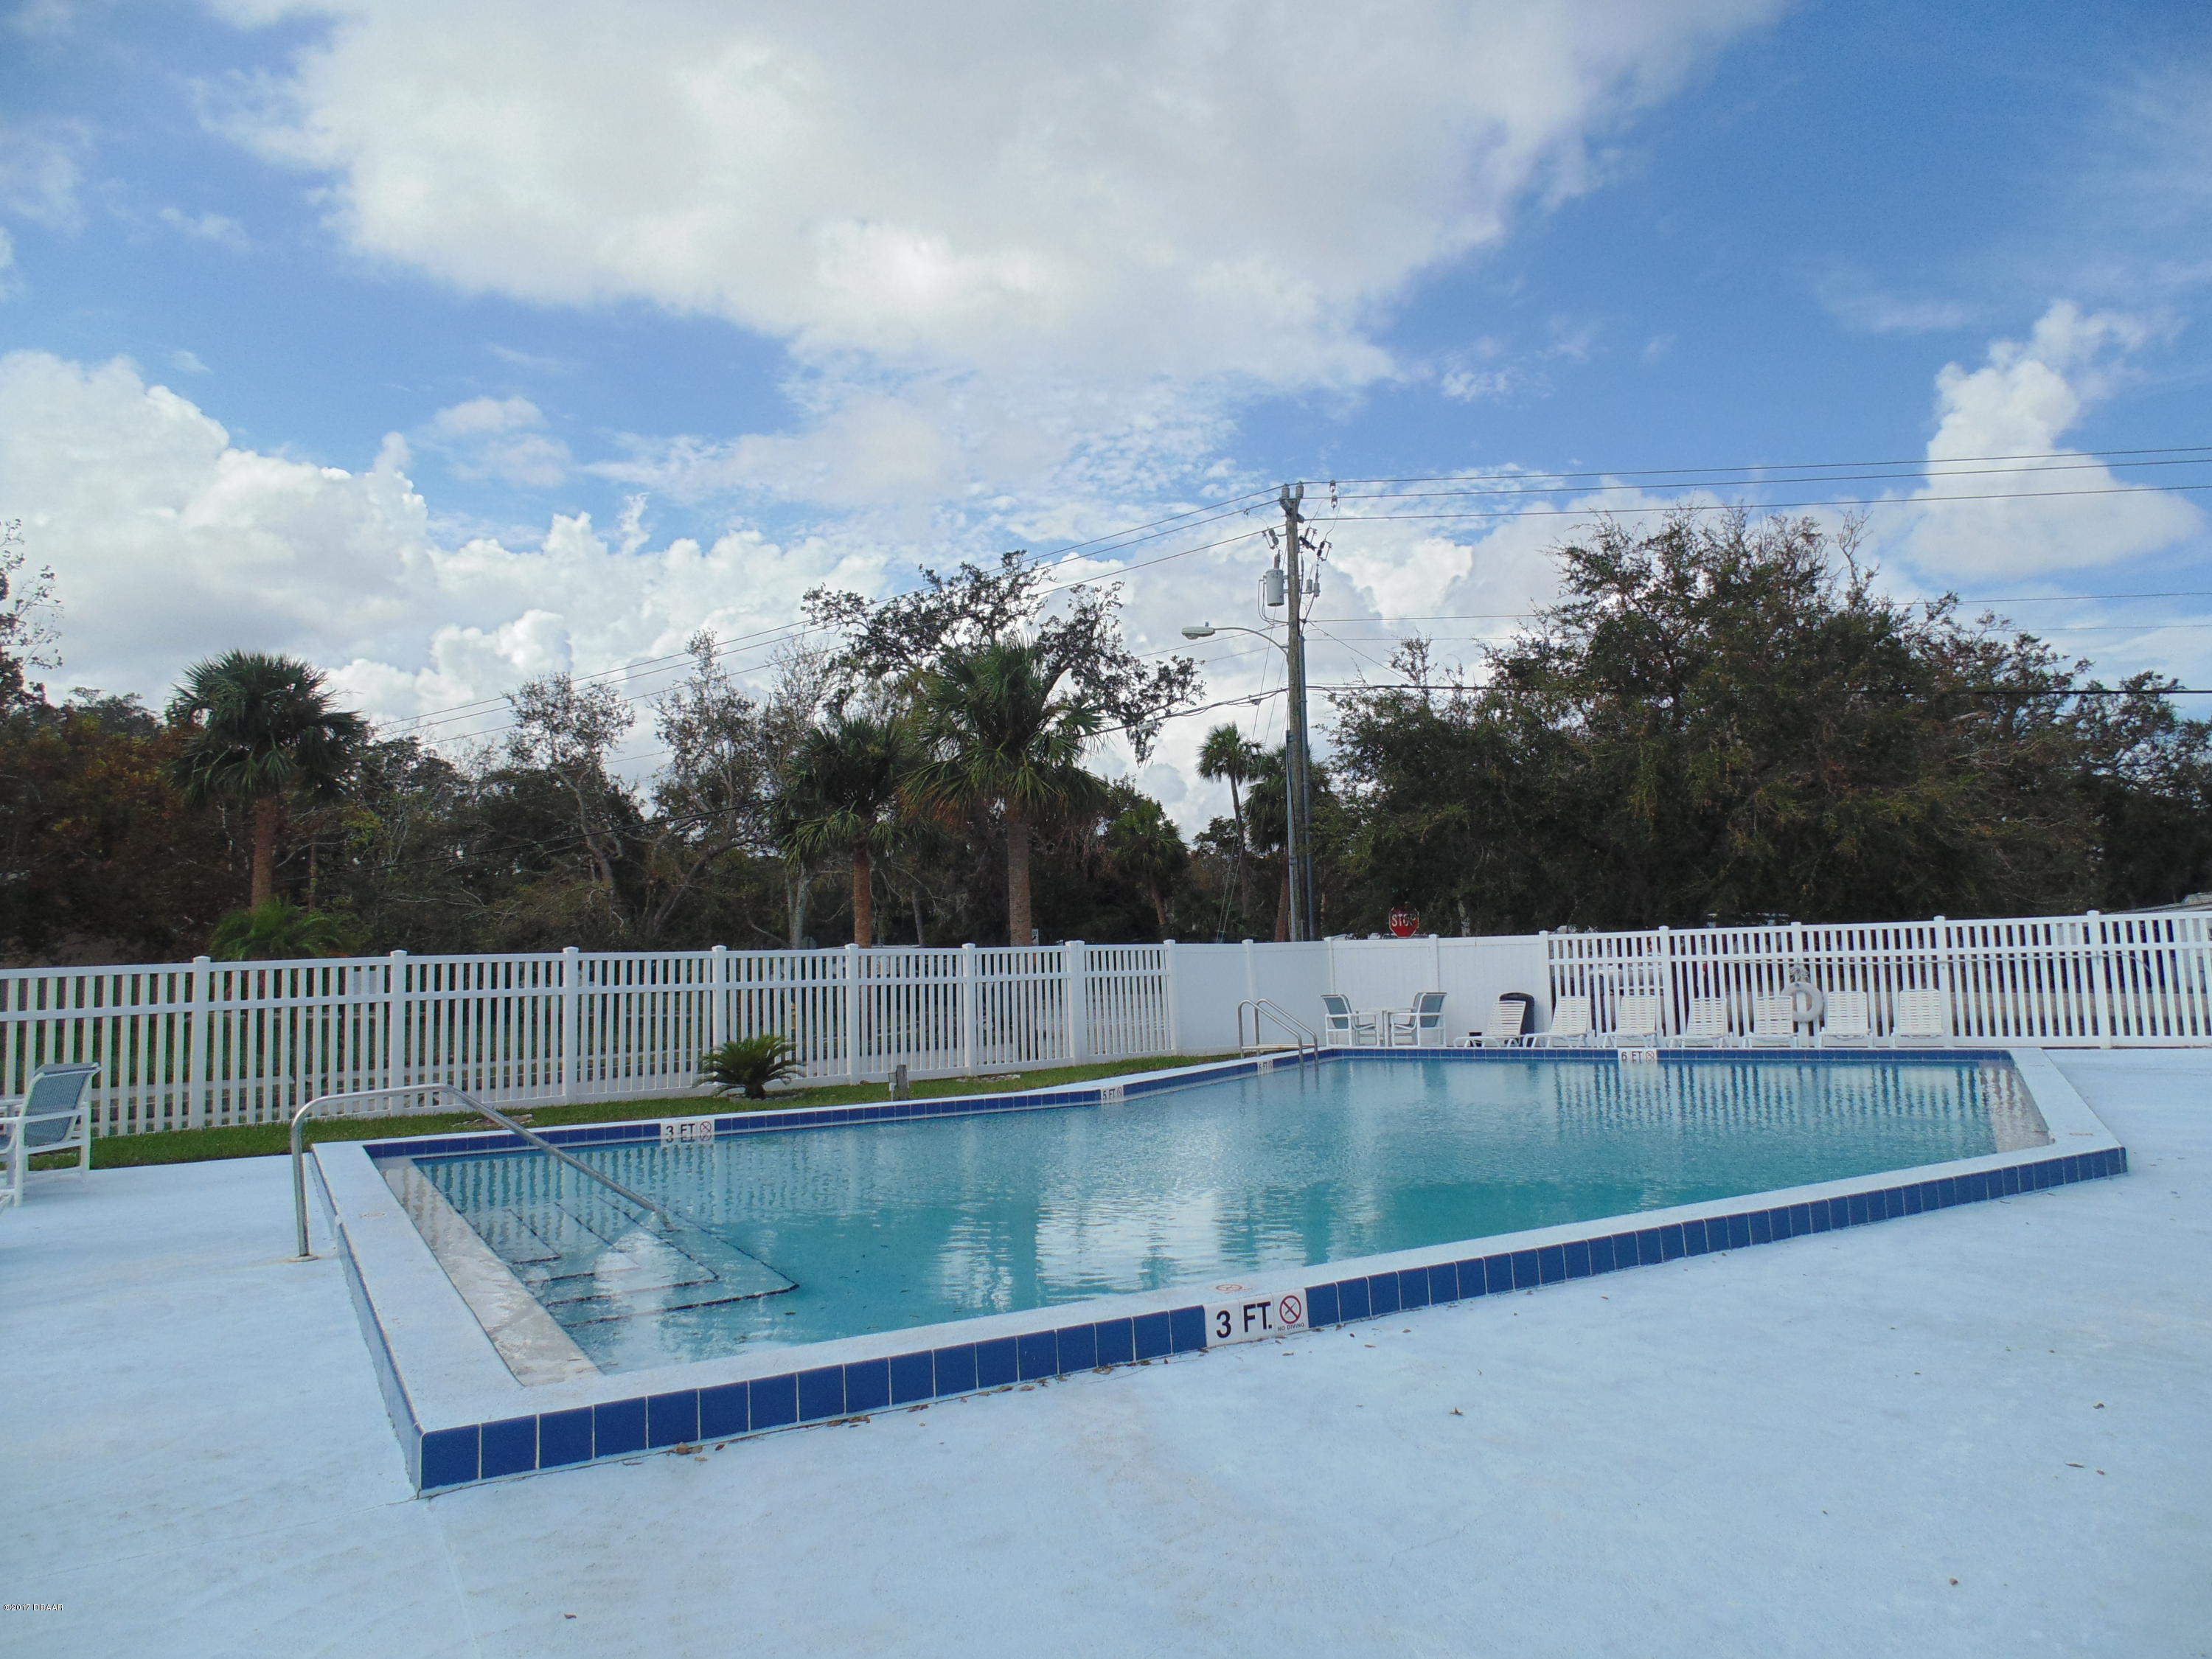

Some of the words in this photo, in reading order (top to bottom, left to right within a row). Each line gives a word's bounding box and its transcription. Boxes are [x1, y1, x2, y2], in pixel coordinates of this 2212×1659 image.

[1391, 914, 1416, 927] STOP
[1621, 1051, 1627, 1062] 6
[1632, 1051, 1642, 1063] FT
[1108, 1088, 1116, 1099] FT
[680, 1123, 695, 1135] FT
[1217, 1310, 1231, 1338] 3
[1243, 1301, 1273, 1332] FT.
